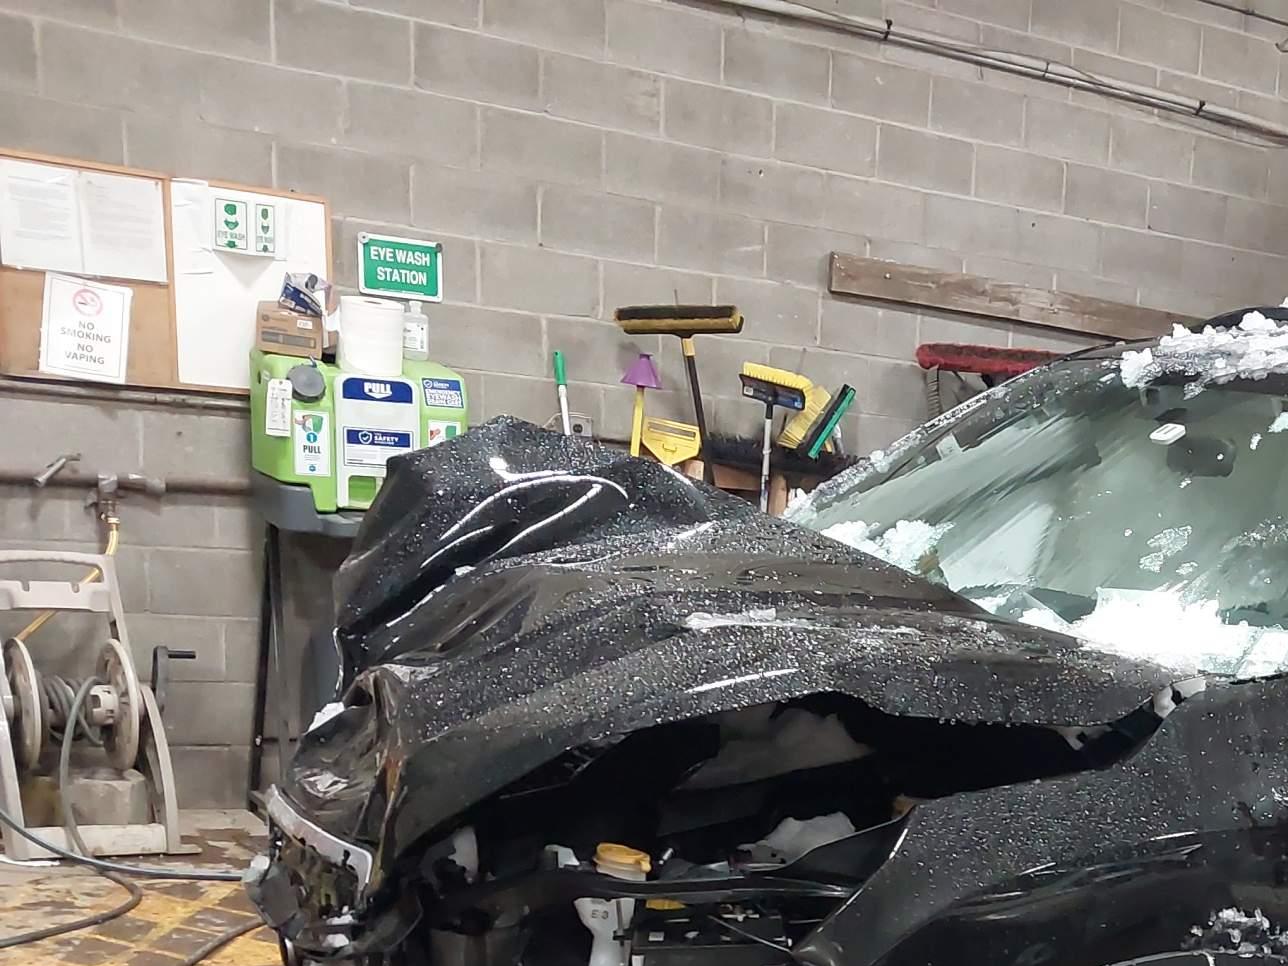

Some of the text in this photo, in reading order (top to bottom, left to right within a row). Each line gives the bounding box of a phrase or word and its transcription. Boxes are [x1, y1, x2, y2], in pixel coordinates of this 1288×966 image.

[370, 246, 430, 267] EYE WASH
[376, 266, 427, 286] STATION
[78, 320, 95, 331] NO
[60, 326, 111, 344] SMOKING
[76, 343, 94, 353] NO
[64, 351, 105, 365] VAPING
[364, 382, 391, 393] PULL
[303, 445, 321, 454] PULL
